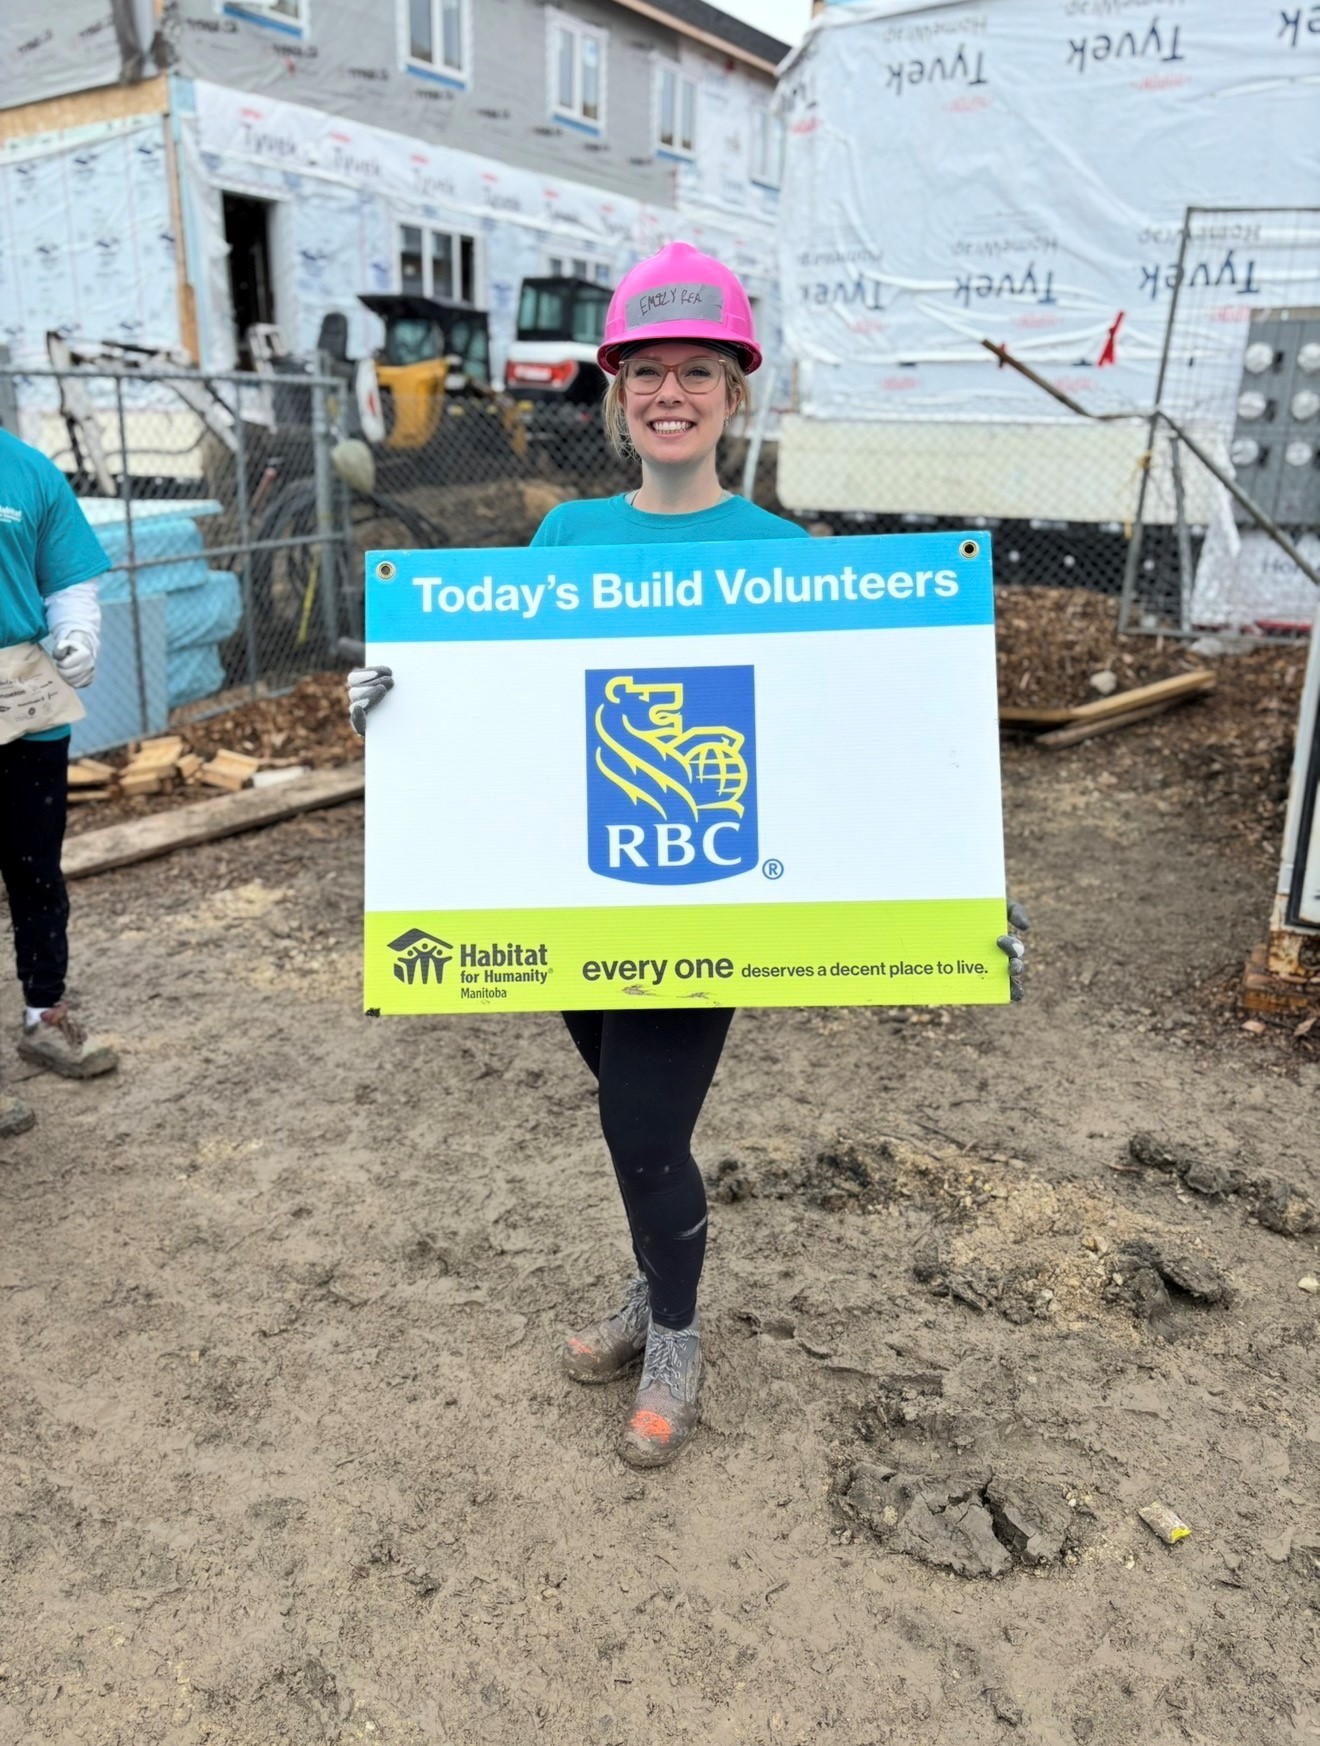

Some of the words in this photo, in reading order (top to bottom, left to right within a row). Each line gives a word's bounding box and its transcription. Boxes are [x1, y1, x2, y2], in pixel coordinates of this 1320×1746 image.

[1066, 15, 1184, 73] Tyvek
[886, 43, 988, 96] Tyvek
[954, 260, 1057, 308] Tyvek
[1139, 249, 1260, 300] Tyvek
[412, 575, 580, 619] Today’s
[592, 570, 703, 609] Build
[714, 566, 960, 605] Volunteers
[604, 821, 743, 869] RBC
[460, 942, 549, 967] Habitat
[460, 970, 480, 984] for
[582, 957, 669, 985] every
[674, 956, 735, 980] one
[741, 962, 815, 978] deserves
[817, 964, 827, 977] a
[830, 961, 887, 977] decent
[889, 960, 935, 979] place
[936, 960, 954, 976] to
[956, 959, 989, 975] live.
[460, 987, 508, 999] Manitoba
